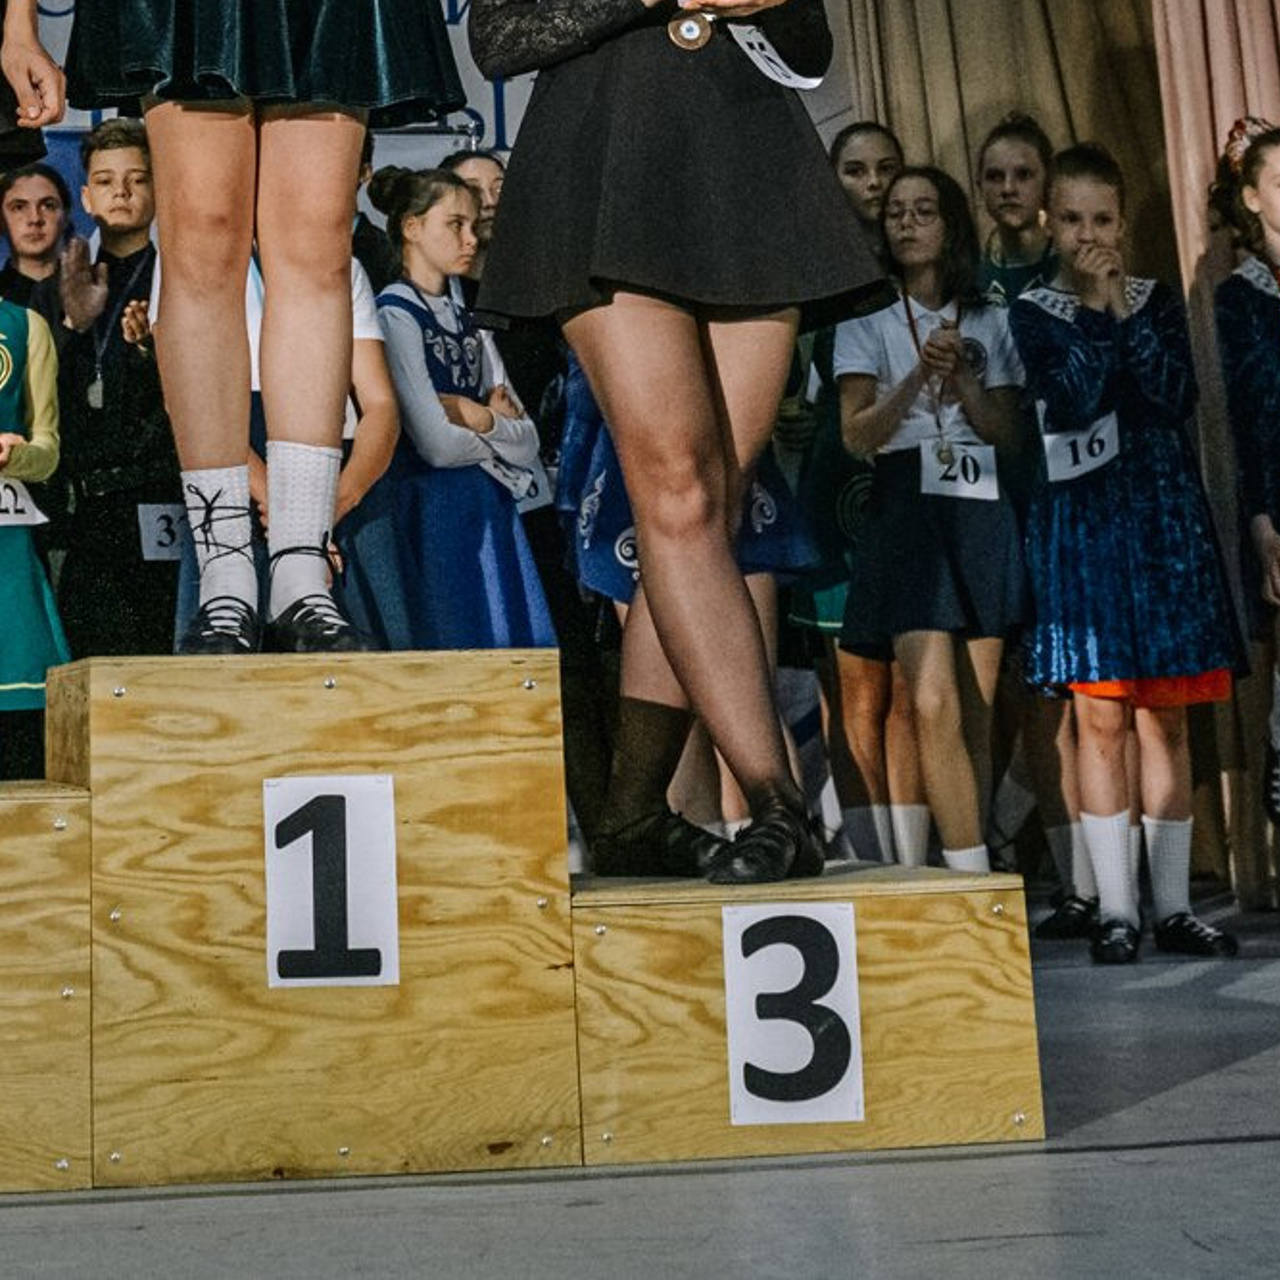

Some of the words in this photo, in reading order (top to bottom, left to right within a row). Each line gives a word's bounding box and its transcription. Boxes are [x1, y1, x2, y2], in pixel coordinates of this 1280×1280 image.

[939, 454, 981, 485] 20
[1068, 426, 1106, 467] 16
[272, 793, 382, 980] 1
[740, 914, 853, 1102] 3
